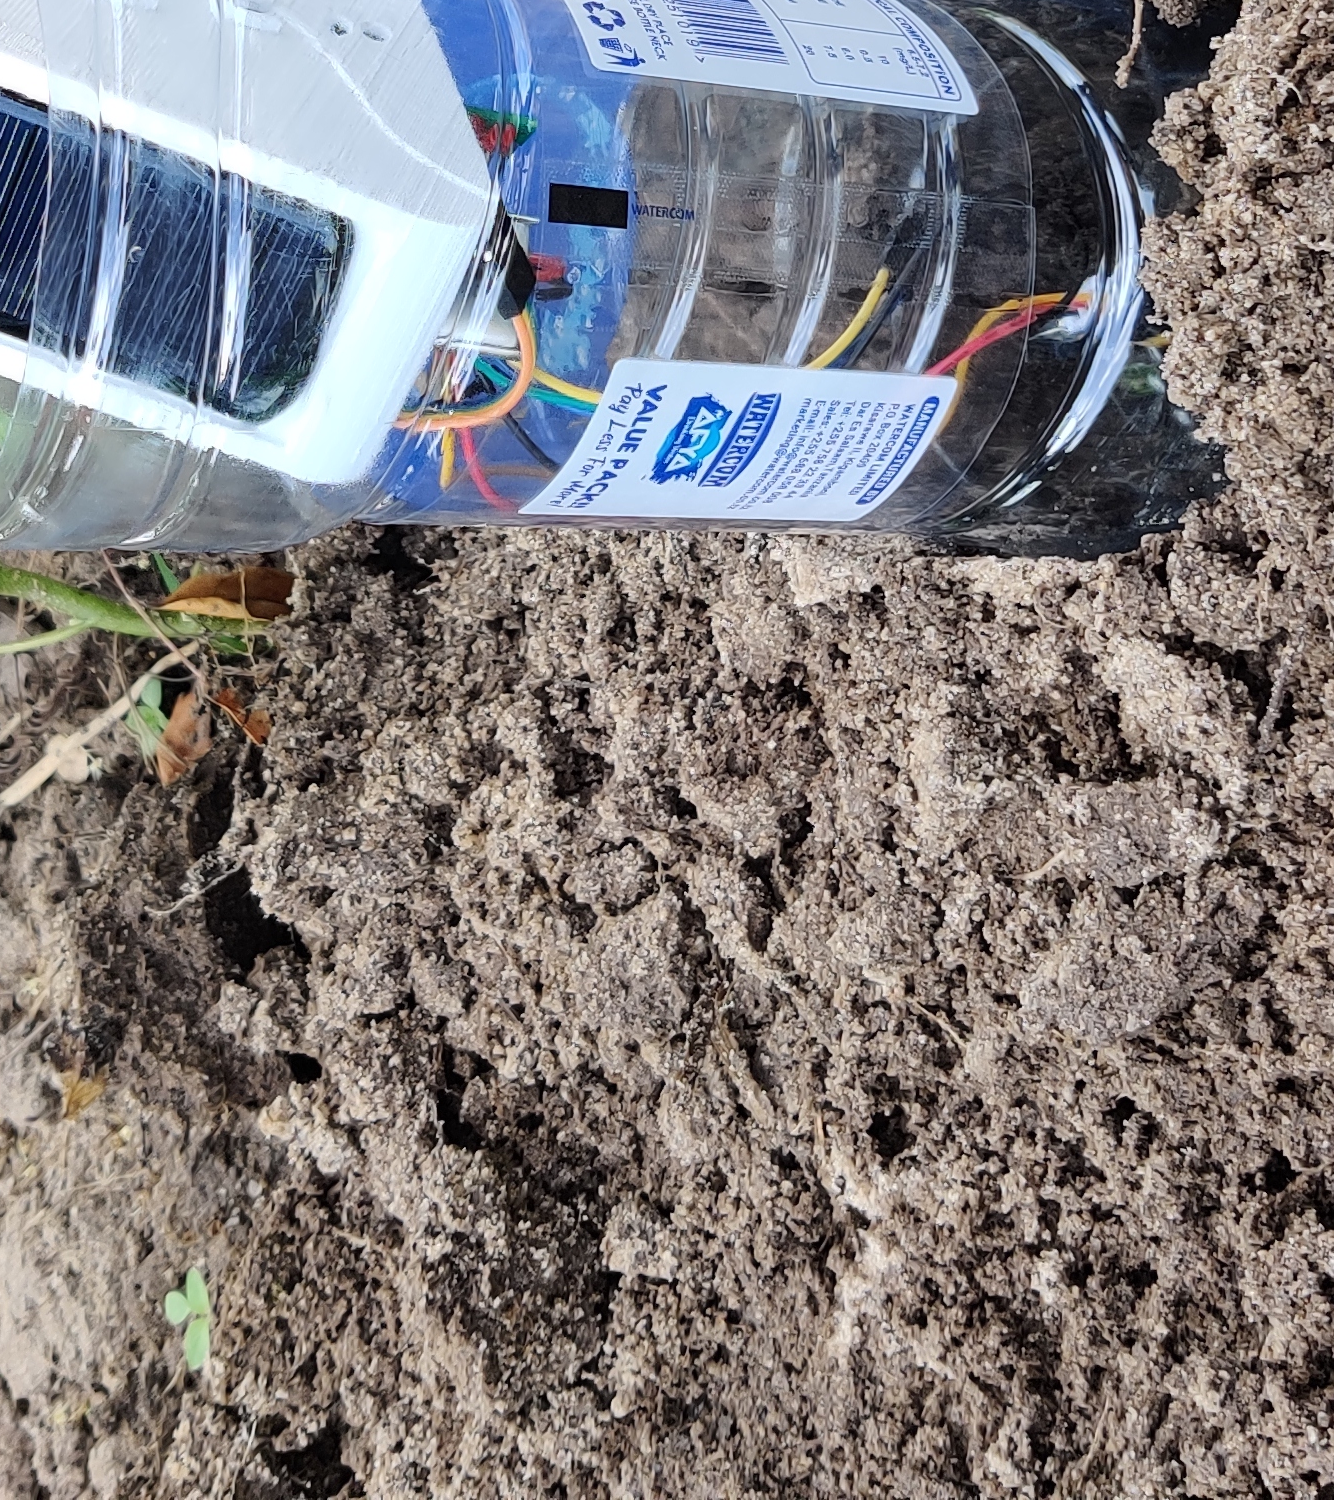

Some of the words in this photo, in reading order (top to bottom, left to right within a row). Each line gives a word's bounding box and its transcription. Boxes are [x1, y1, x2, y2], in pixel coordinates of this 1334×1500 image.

[633, 7, 655, 33] BOTTLE
[648, 36, 667, 61] NECK
[643, 4, 660, 18] DRY
[653, 20, 674, 46] PLACE
[895, 17, 955, 95] COMPOSITION
[631, 203, 695, 221] WATERCOM
[608, 383, 643, 414] Pay
[819, 400, 841, 428] Sales:
[840, 400, 857, 417] Tel:
[857, 402, 871, 418] Dar
[617, 385, 667, 453] VALUE
[803, 401, 827, 433] E-mail:
[849, 421, 862, 432] Es
[856, 403, 887, 444] Kisarawe
[873, 423, 891, 439] Box
[875, 404, 917, 461] WATERCOM
[596, 419, 627, 451] Less
[664, 406, 717, 472] AFYA
[701, 394, 777, 487] WATERCOM
[804, 431, 823, 455] +255
[826, 421, 845, 445] +255
[873, 403, 937, 488] MANUFACTURED
[578, 457, 607, 477] For
[848, 464, 882, 495] LIMITED
[547, 481, 586, 507] More!
[566, 459, 629, 508] PACK!!
[861, 490, 880, 501] BY
